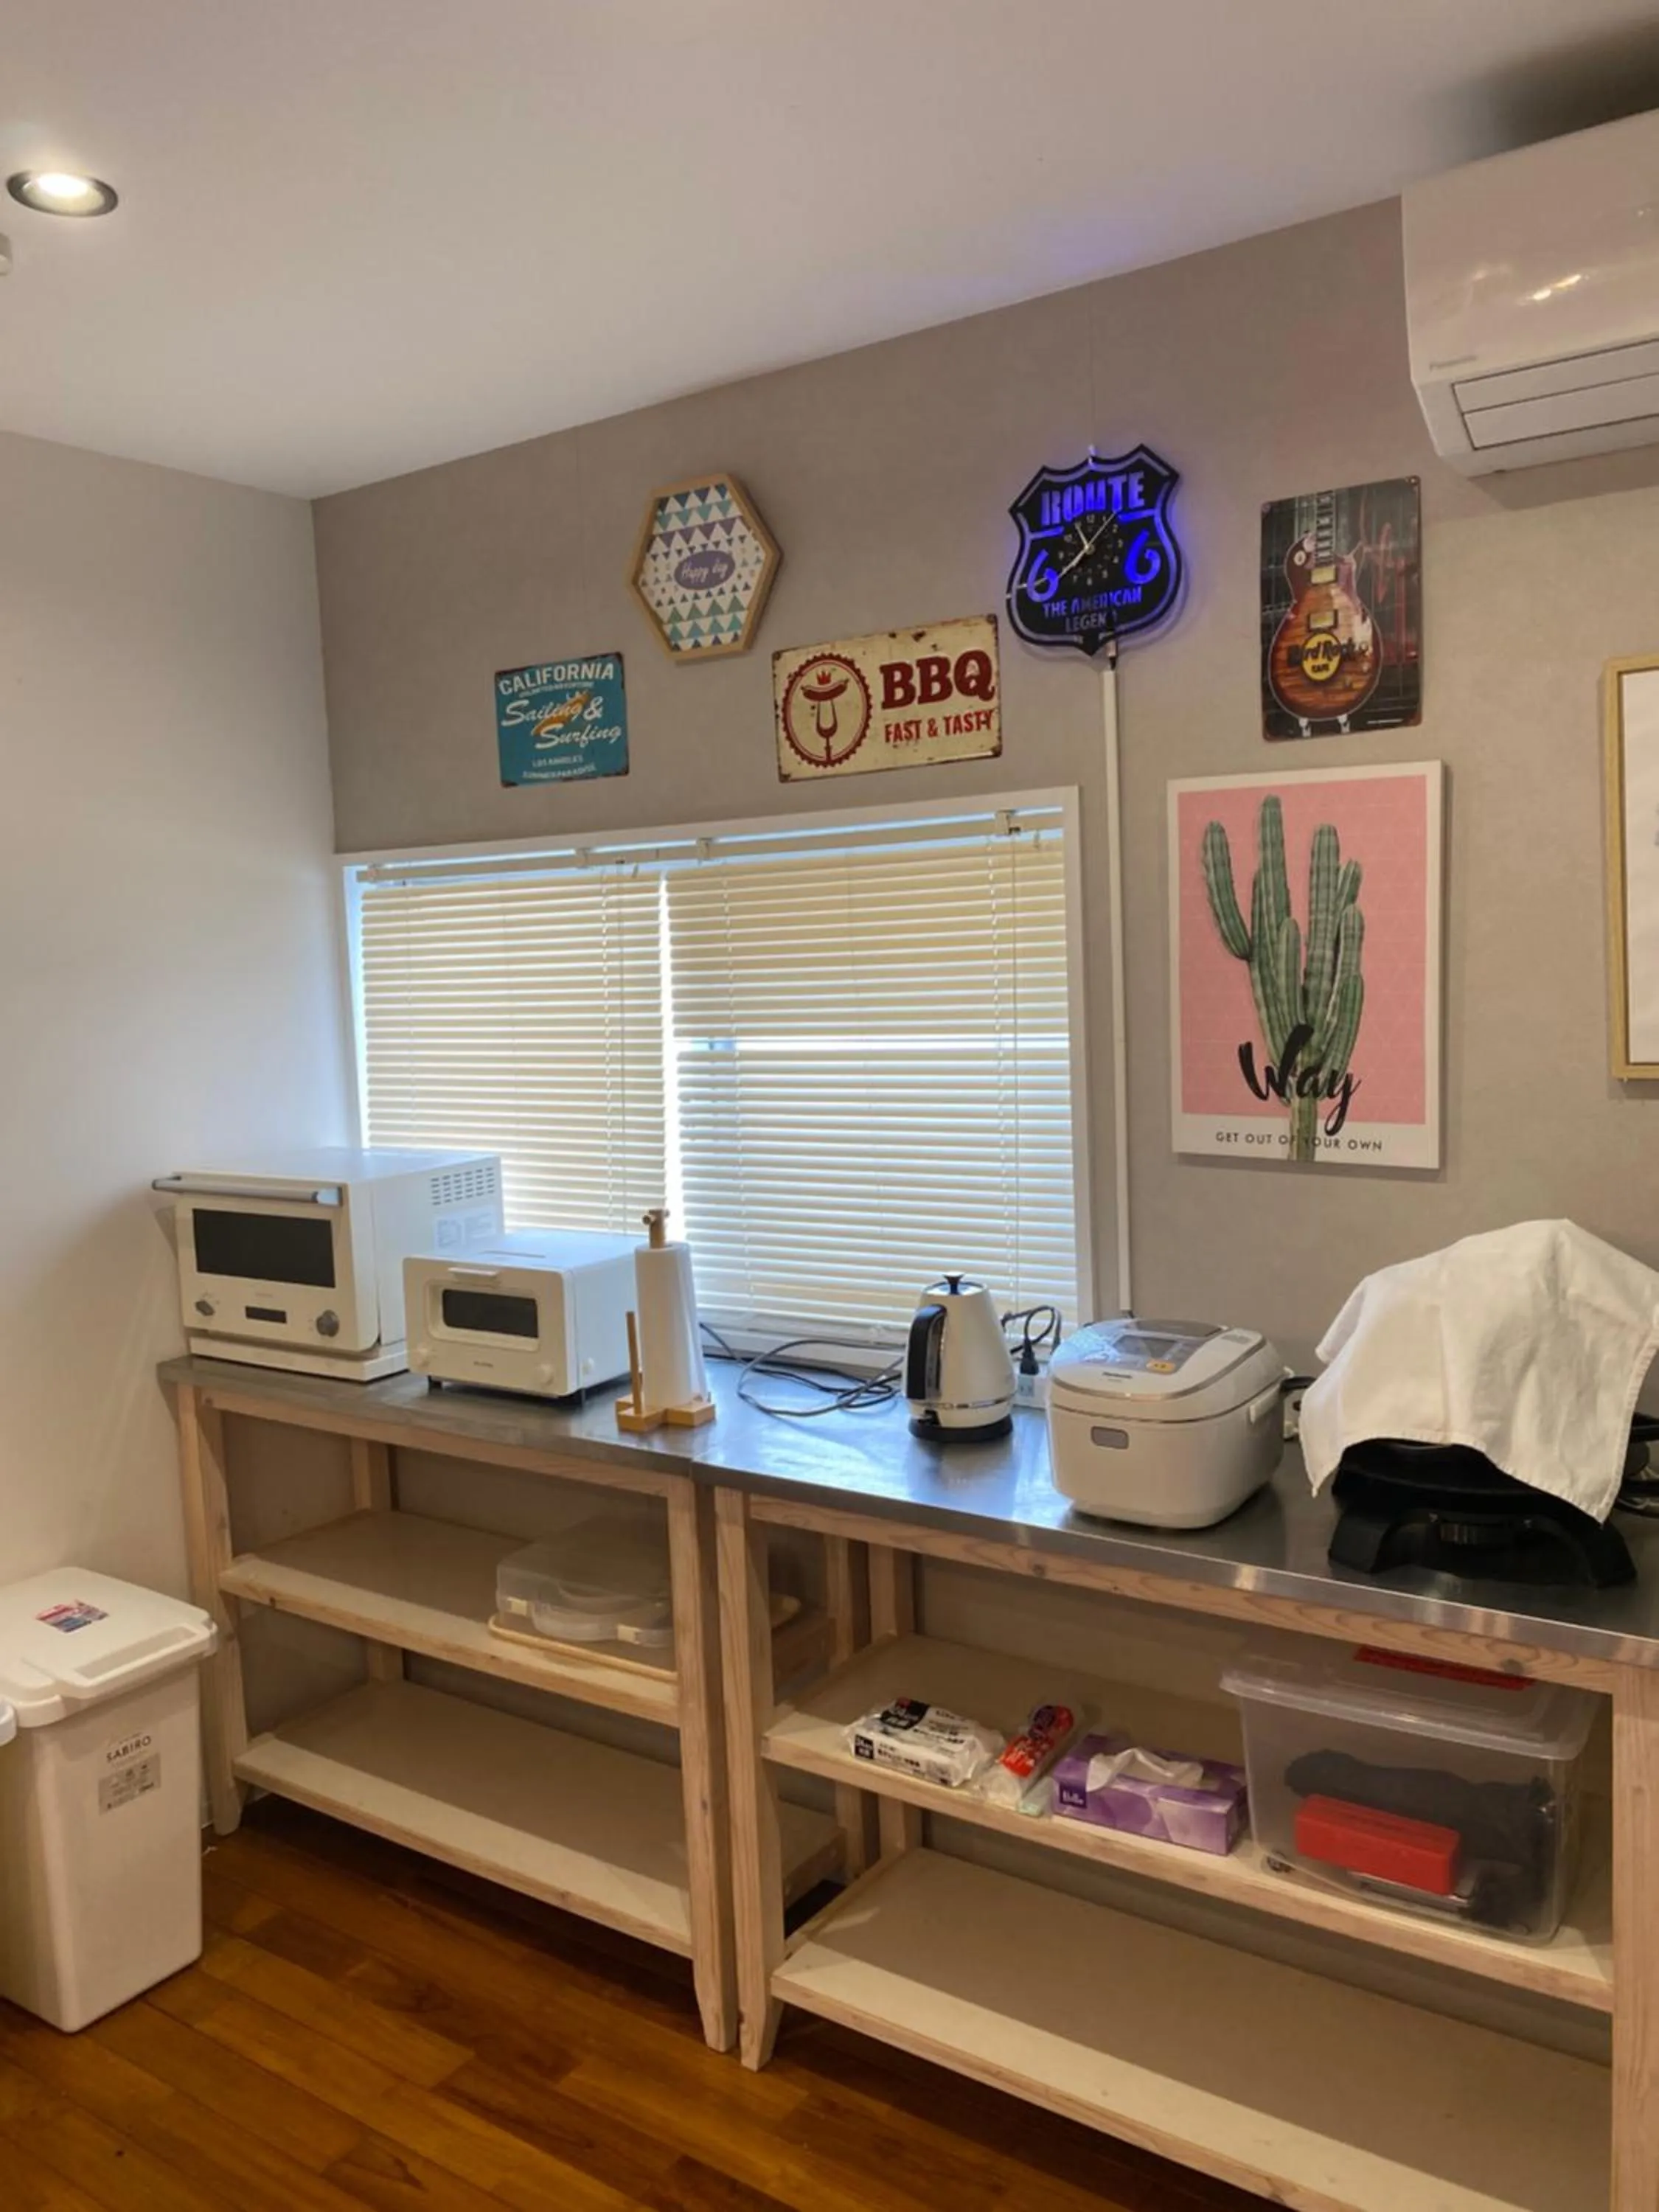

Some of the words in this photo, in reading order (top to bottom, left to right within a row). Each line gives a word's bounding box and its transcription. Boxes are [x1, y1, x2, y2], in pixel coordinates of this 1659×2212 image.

[1041, 472, 1145, 526] ROUTE
[1043, 599, 1067, 618] THE
[1071, 586, 1142, 614] AMERICAN
[498, 662, 614, 695] CALIFORNIA
[880, 650, 995, 710] BBQ
[501, 699, 583, 726] Sailing
[583, 695, 604, 720] &
[885, 719, 922, 743] FAST
[927, 717, 938, 737] &
[943, 709, 995, 736] TASTY
[535, 723, 622, 750] Surfing
[1238, 1023, 1362, 1136] Way
[1215, 1132, 1239, 1143] GET
[1245, 1133, 1273, 1145] OUT
[1348, 1139, 1382, 1152] OWN
